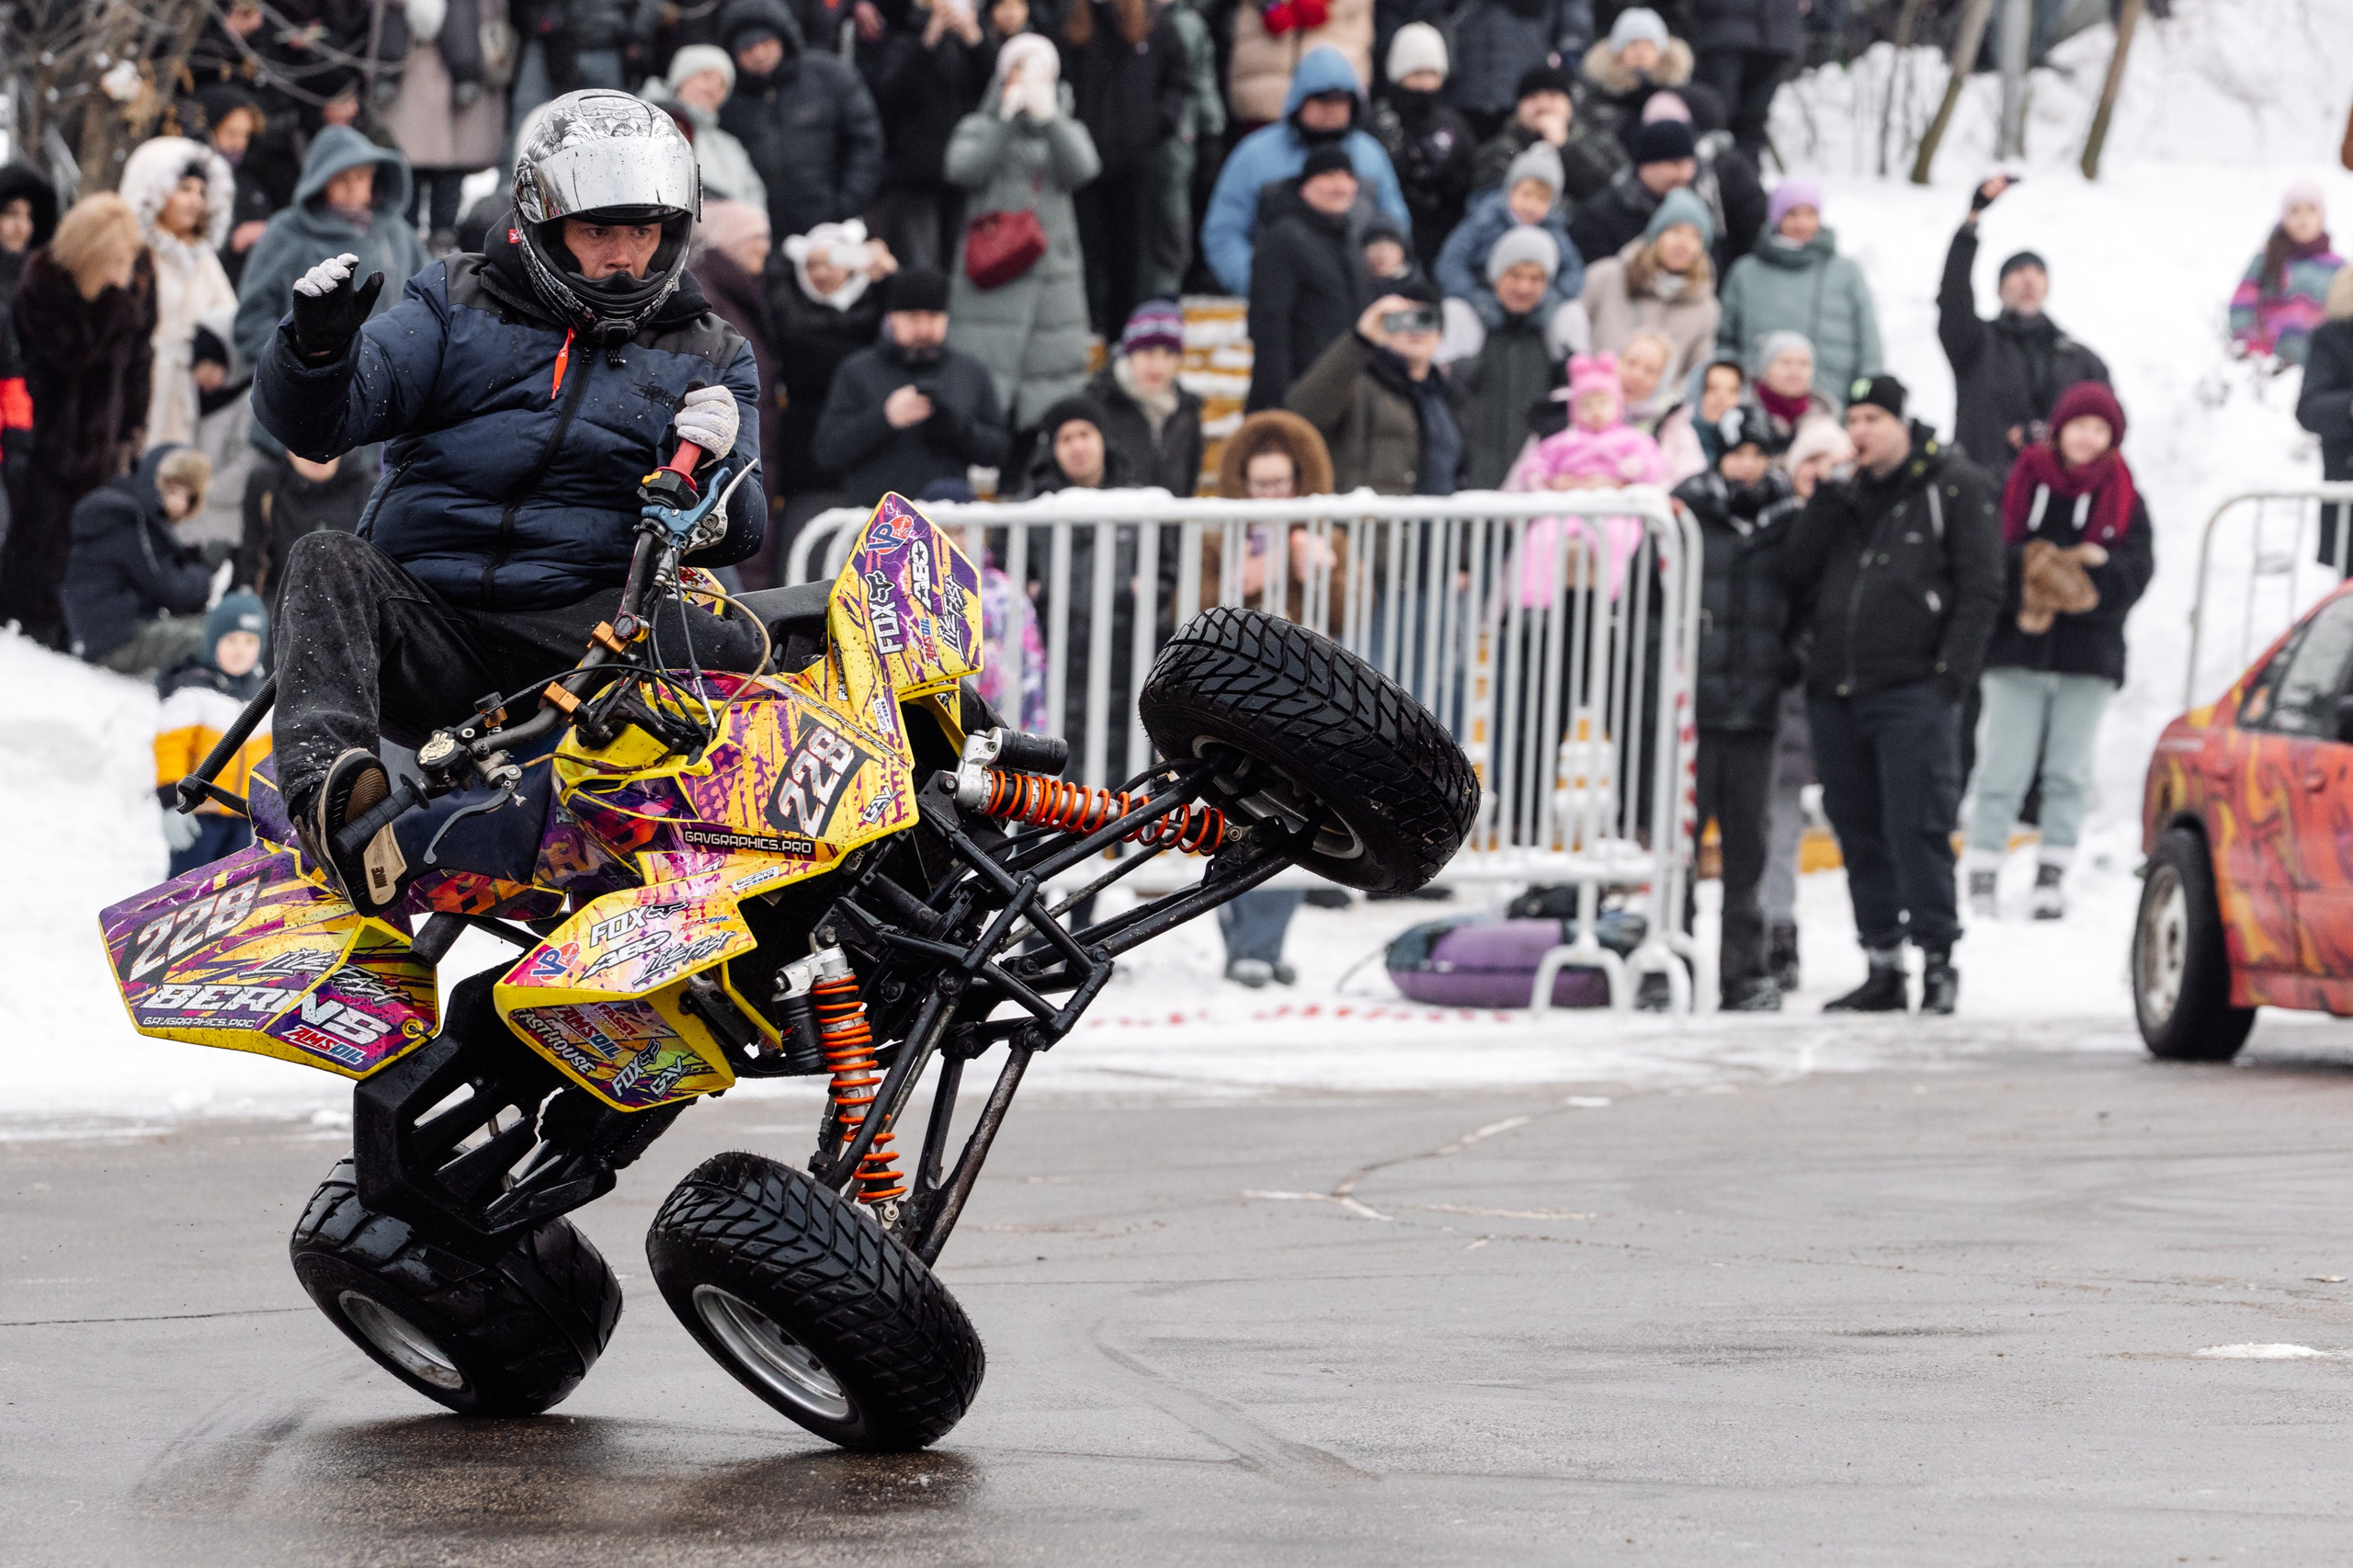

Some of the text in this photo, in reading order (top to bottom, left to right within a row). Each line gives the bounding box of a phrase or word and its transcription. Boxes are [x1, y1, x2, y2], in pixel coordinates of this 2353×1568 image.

[870, 601, 904, 654] FOX
[919, 618, 938, 665] AMSOIL
[777, 725, 856, 839] 228
[685, 830, 812, 854] GAVGRAPHICS.PRO
[129, 876, 260, 983] 228
[590, 906, 647, 948] FOX
[677, 915, 731, 935] AMSOIL
[142, 984, 393, 1046] BERNS
[554, 1006, 623, 1060] AMSOIL
[286, 1026, 367, 1064] AMSOIL
[513, 1007, 597, 1074] FASTHOUSE
[611, 1056, 646, 1097] FOX
[649, 1056, 682, 1096] GAV
